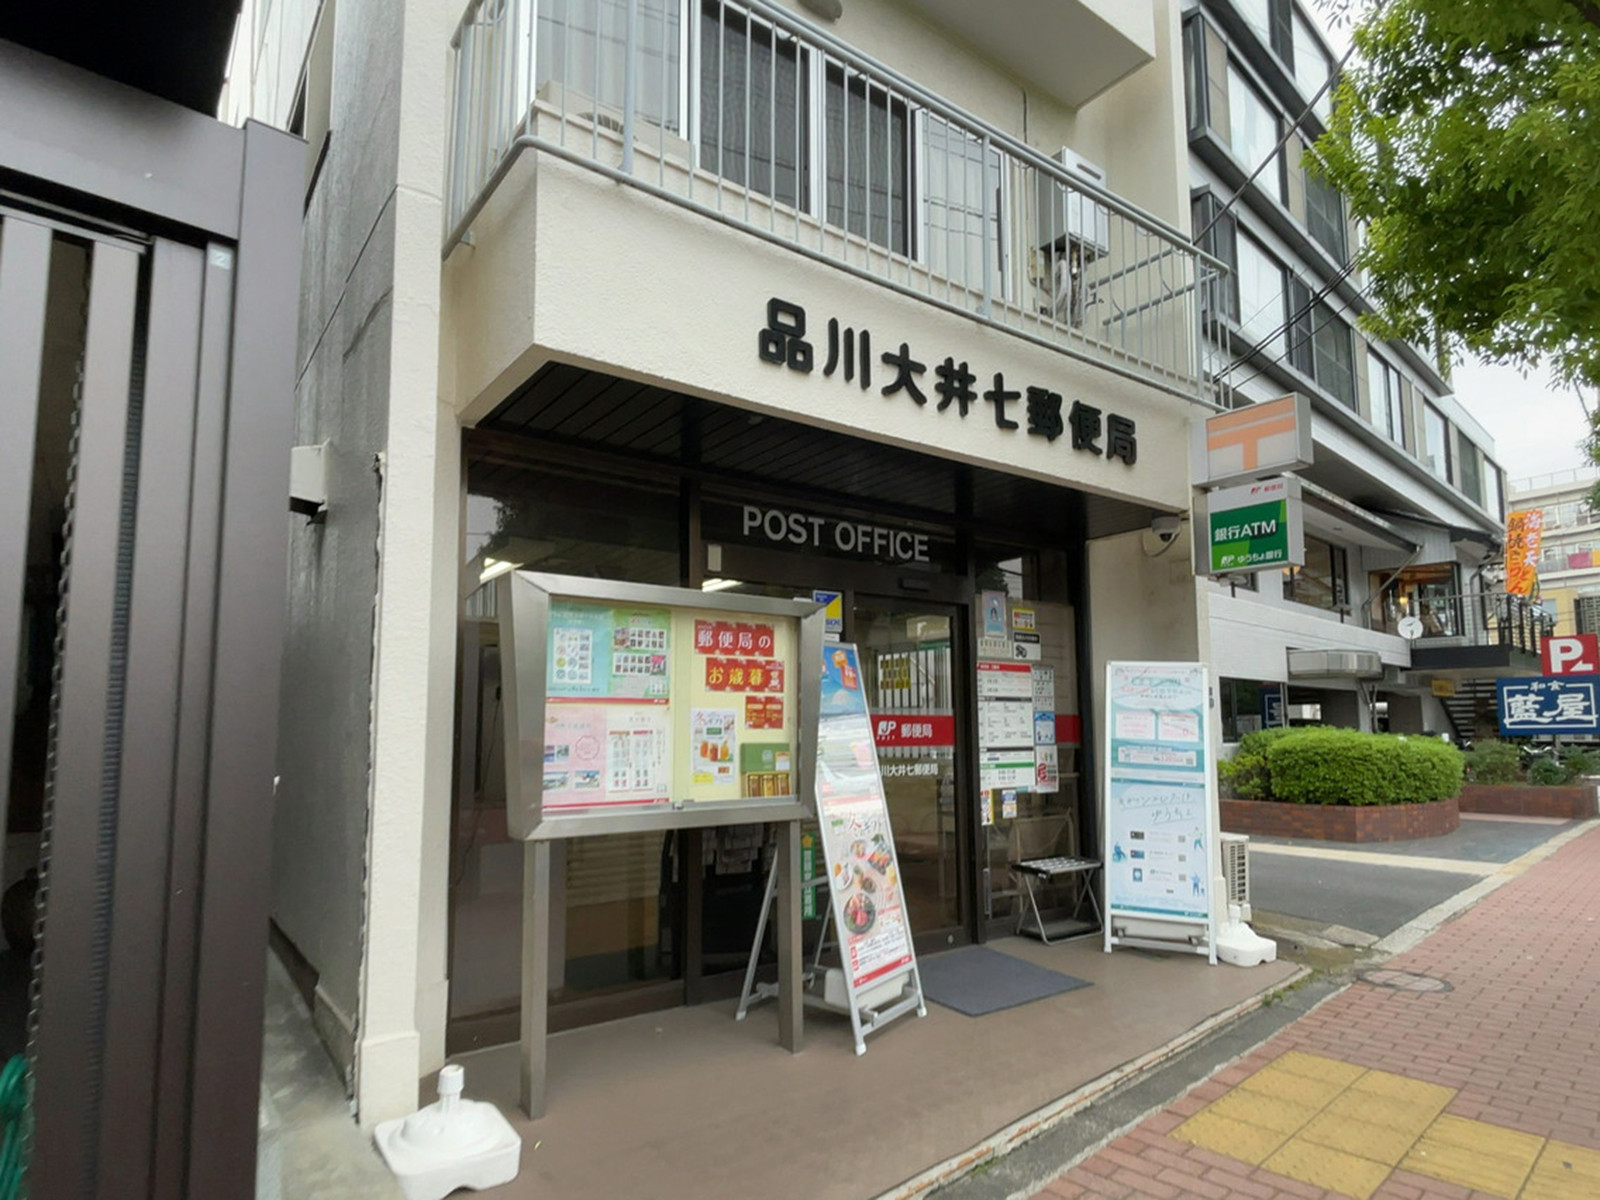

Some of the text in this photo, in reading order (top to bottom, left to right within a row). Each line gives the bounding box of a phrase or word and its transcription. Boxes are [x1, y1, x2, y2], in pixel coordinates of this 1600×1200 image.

[758, 297, 1138, 466] 品川大井七郵便局
[742, 505, 930, 562] POST OFFICE
[1214, 519, 1276, 542] 銀行ATM
[697, 629, 772, 650] 郵便局の
[1548, 637, 1584, 674] P
[708, 666, 764, 686] お歳暮
[1529, 679, 1566, 692] 和食
[1503, 692, 1599, 724] 藍屋
[900, 722, 933, 739] 郵便局
